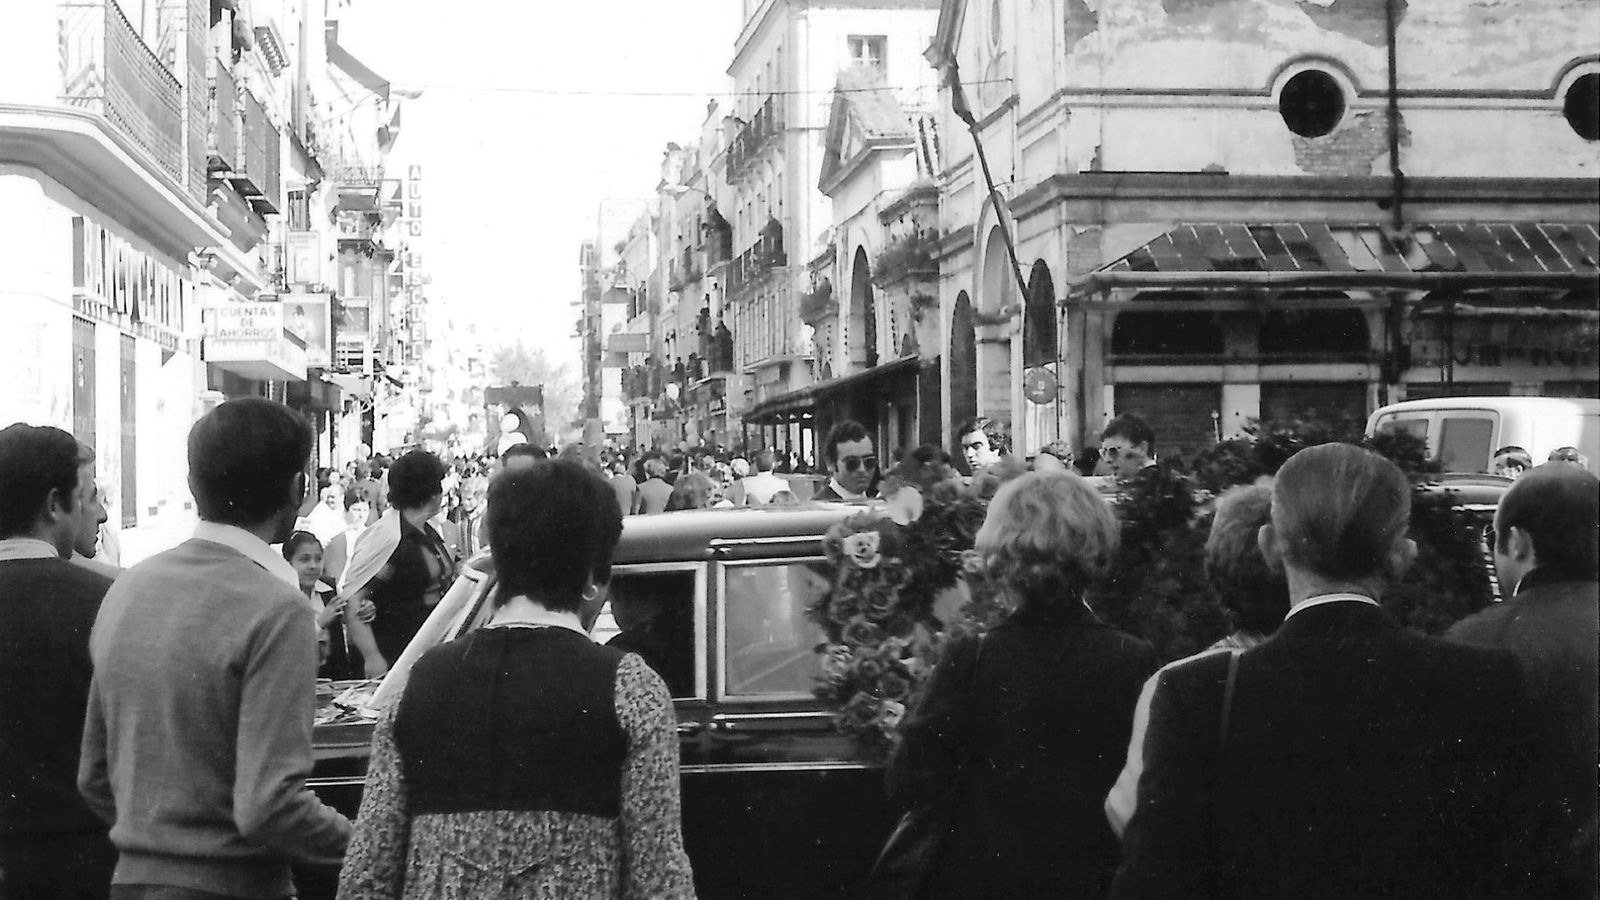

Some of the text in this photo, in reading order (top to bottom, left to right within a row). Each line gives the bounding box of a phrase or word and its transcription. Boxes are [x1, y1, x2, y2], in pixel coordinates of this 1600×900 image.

[409, 165, 422, 236] AUTO
[220, 306, 277, 317] CUENTAS
[240, 317, 255, 328] DE
[219, 328, 278, 338] AHORROS
